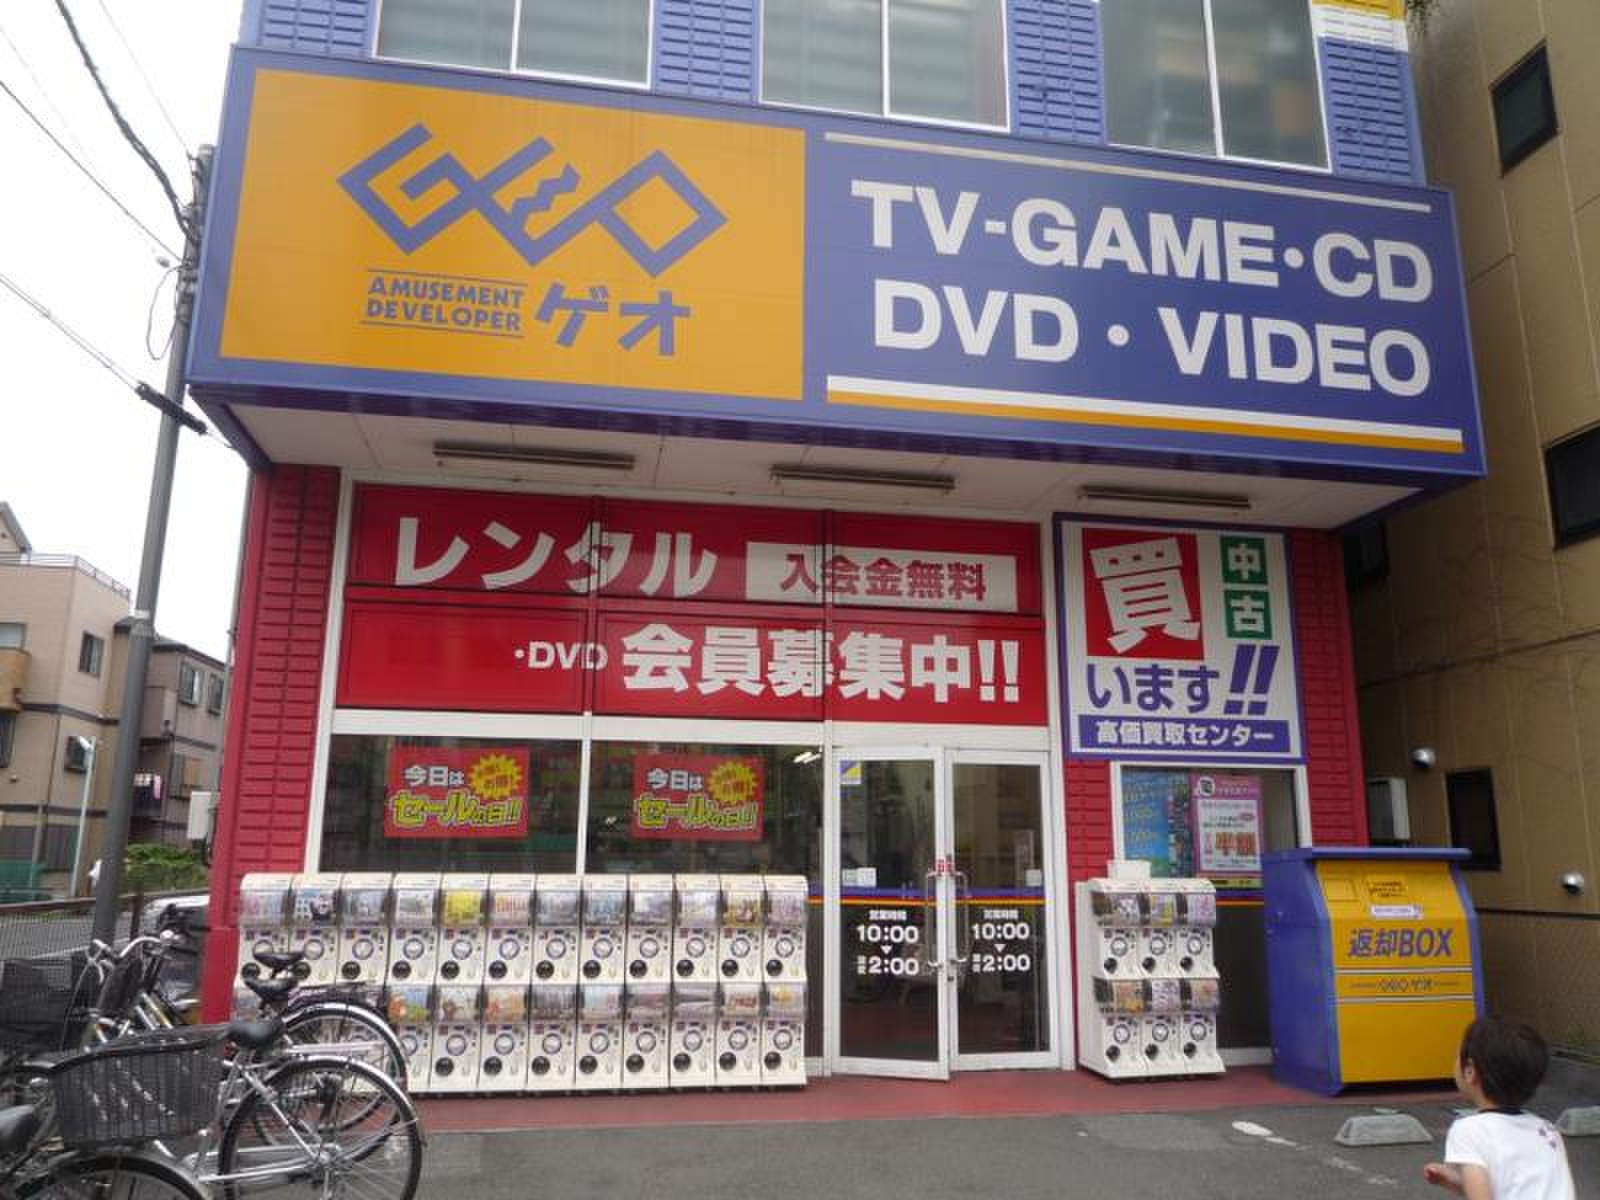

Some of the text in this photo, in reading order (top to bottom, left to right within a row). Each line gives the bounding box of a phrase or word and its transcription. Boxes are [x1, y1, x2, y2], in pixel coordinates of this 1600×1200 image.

[368, 276, 525, 308] AMUSEMENT
[367, 298, 521, 331] DEVELOPER
[535, 282, 691, 357] ゲオ
[395, 517, 718, 599] レンタル
[780, 553, 986, 601] 入会金無料
[1226, 543, 1265, 633] 中古
[1089, 536, 1201, 655] 買
[621, 623, 1020, 704] 会員募集中!!
[1096, 720, 1275, 747] 高価買取センター
[405, 764, 465, 787] 今日は
[647, 768, 704, 791] 今日は
[857, 924, 919, 943] 10:00
[972, 922, 1030, 940] 10:00
[1347, 927, 1455, 958] 返却BOX
[868, 955, 919, 976] 2:00
[982, 954, 1031, 972] 2:00
